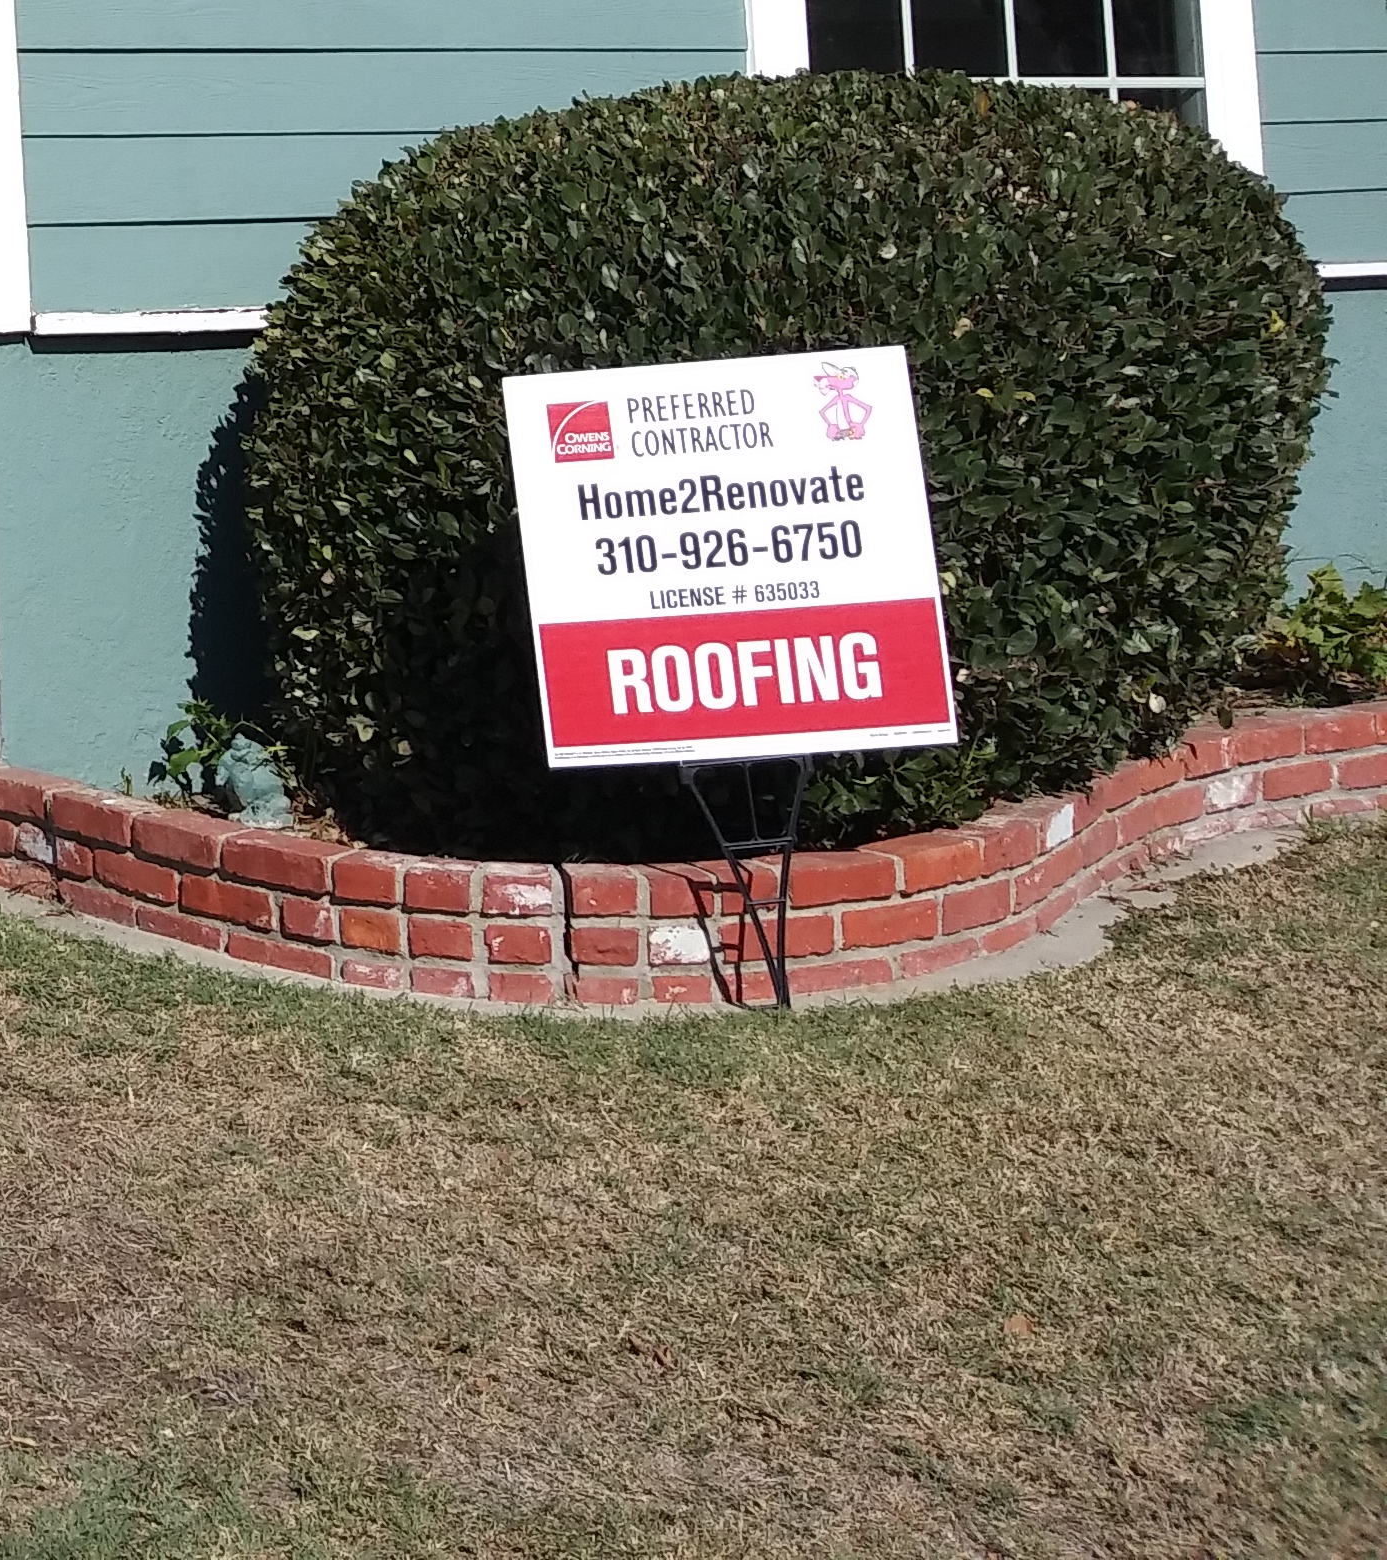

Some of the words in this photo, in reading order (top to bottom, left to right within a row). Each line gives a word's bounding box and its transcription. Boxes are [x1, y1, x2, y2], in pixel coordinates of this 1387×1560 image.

[627, 389, 755, 424] PREFERRED
[556, 442, 612, 455] CORNING
[564, 431, 610, 444] OWENS
[631, 422, 774, 457] CONTRACTOR
[577, 465, 865, 520] Home2Renovate
[594, 520, 863, 576] 310-926-6750
[649, 586, 726, 610] LICENSE
[731, 584, 748, 604] #
[754, 581, 820, 603] 635033
[606, 631, 884, 715] ROOFING
